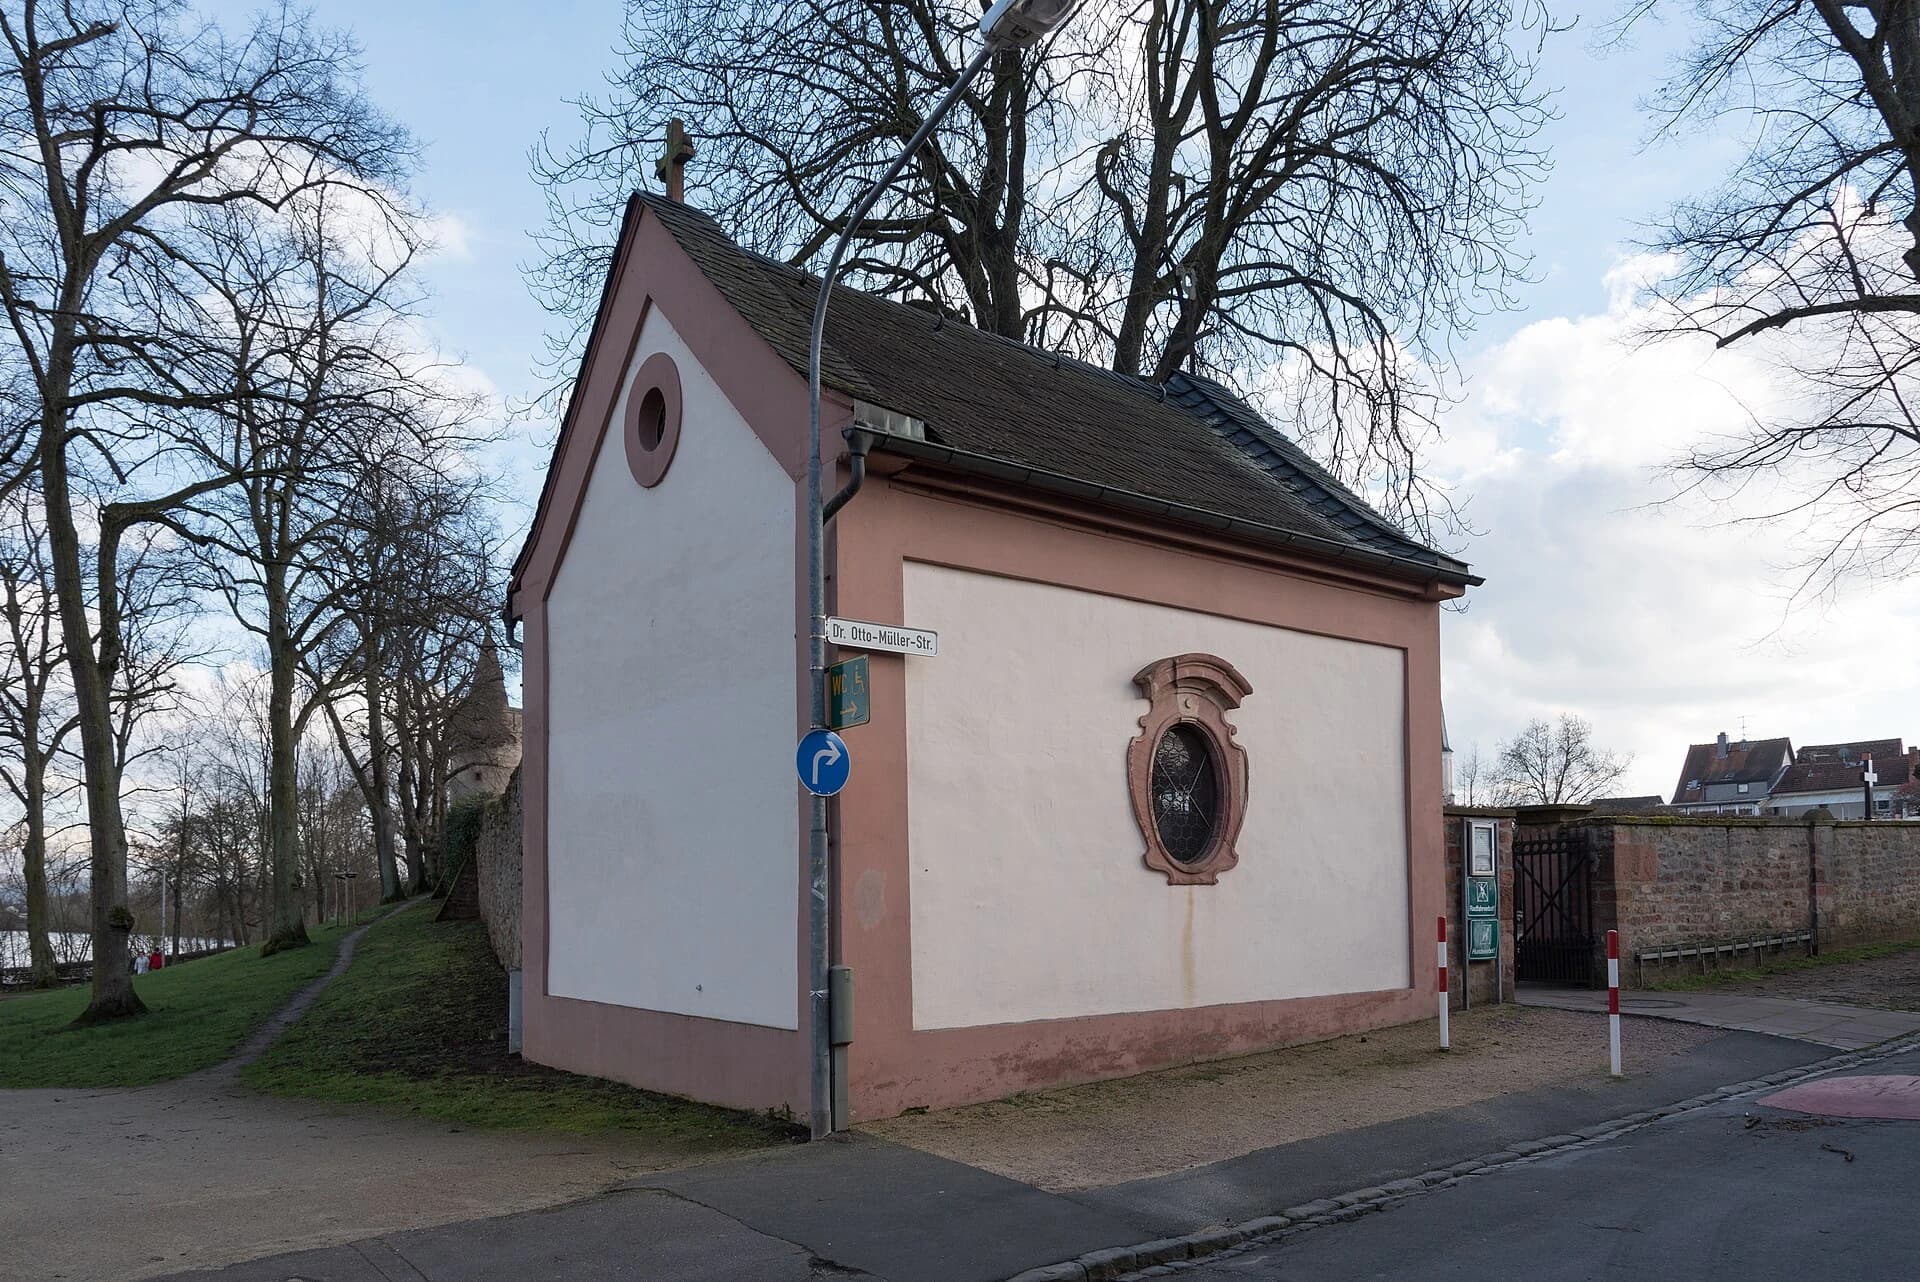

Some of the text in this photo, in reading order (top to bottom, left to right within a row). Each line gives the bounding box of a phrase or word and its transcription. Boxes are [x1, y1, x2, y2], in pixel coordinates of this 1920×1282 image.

[832, 623, 933, 651] Dr. Otto-Müller-Str.
[832, 673, 847, 697] WC
